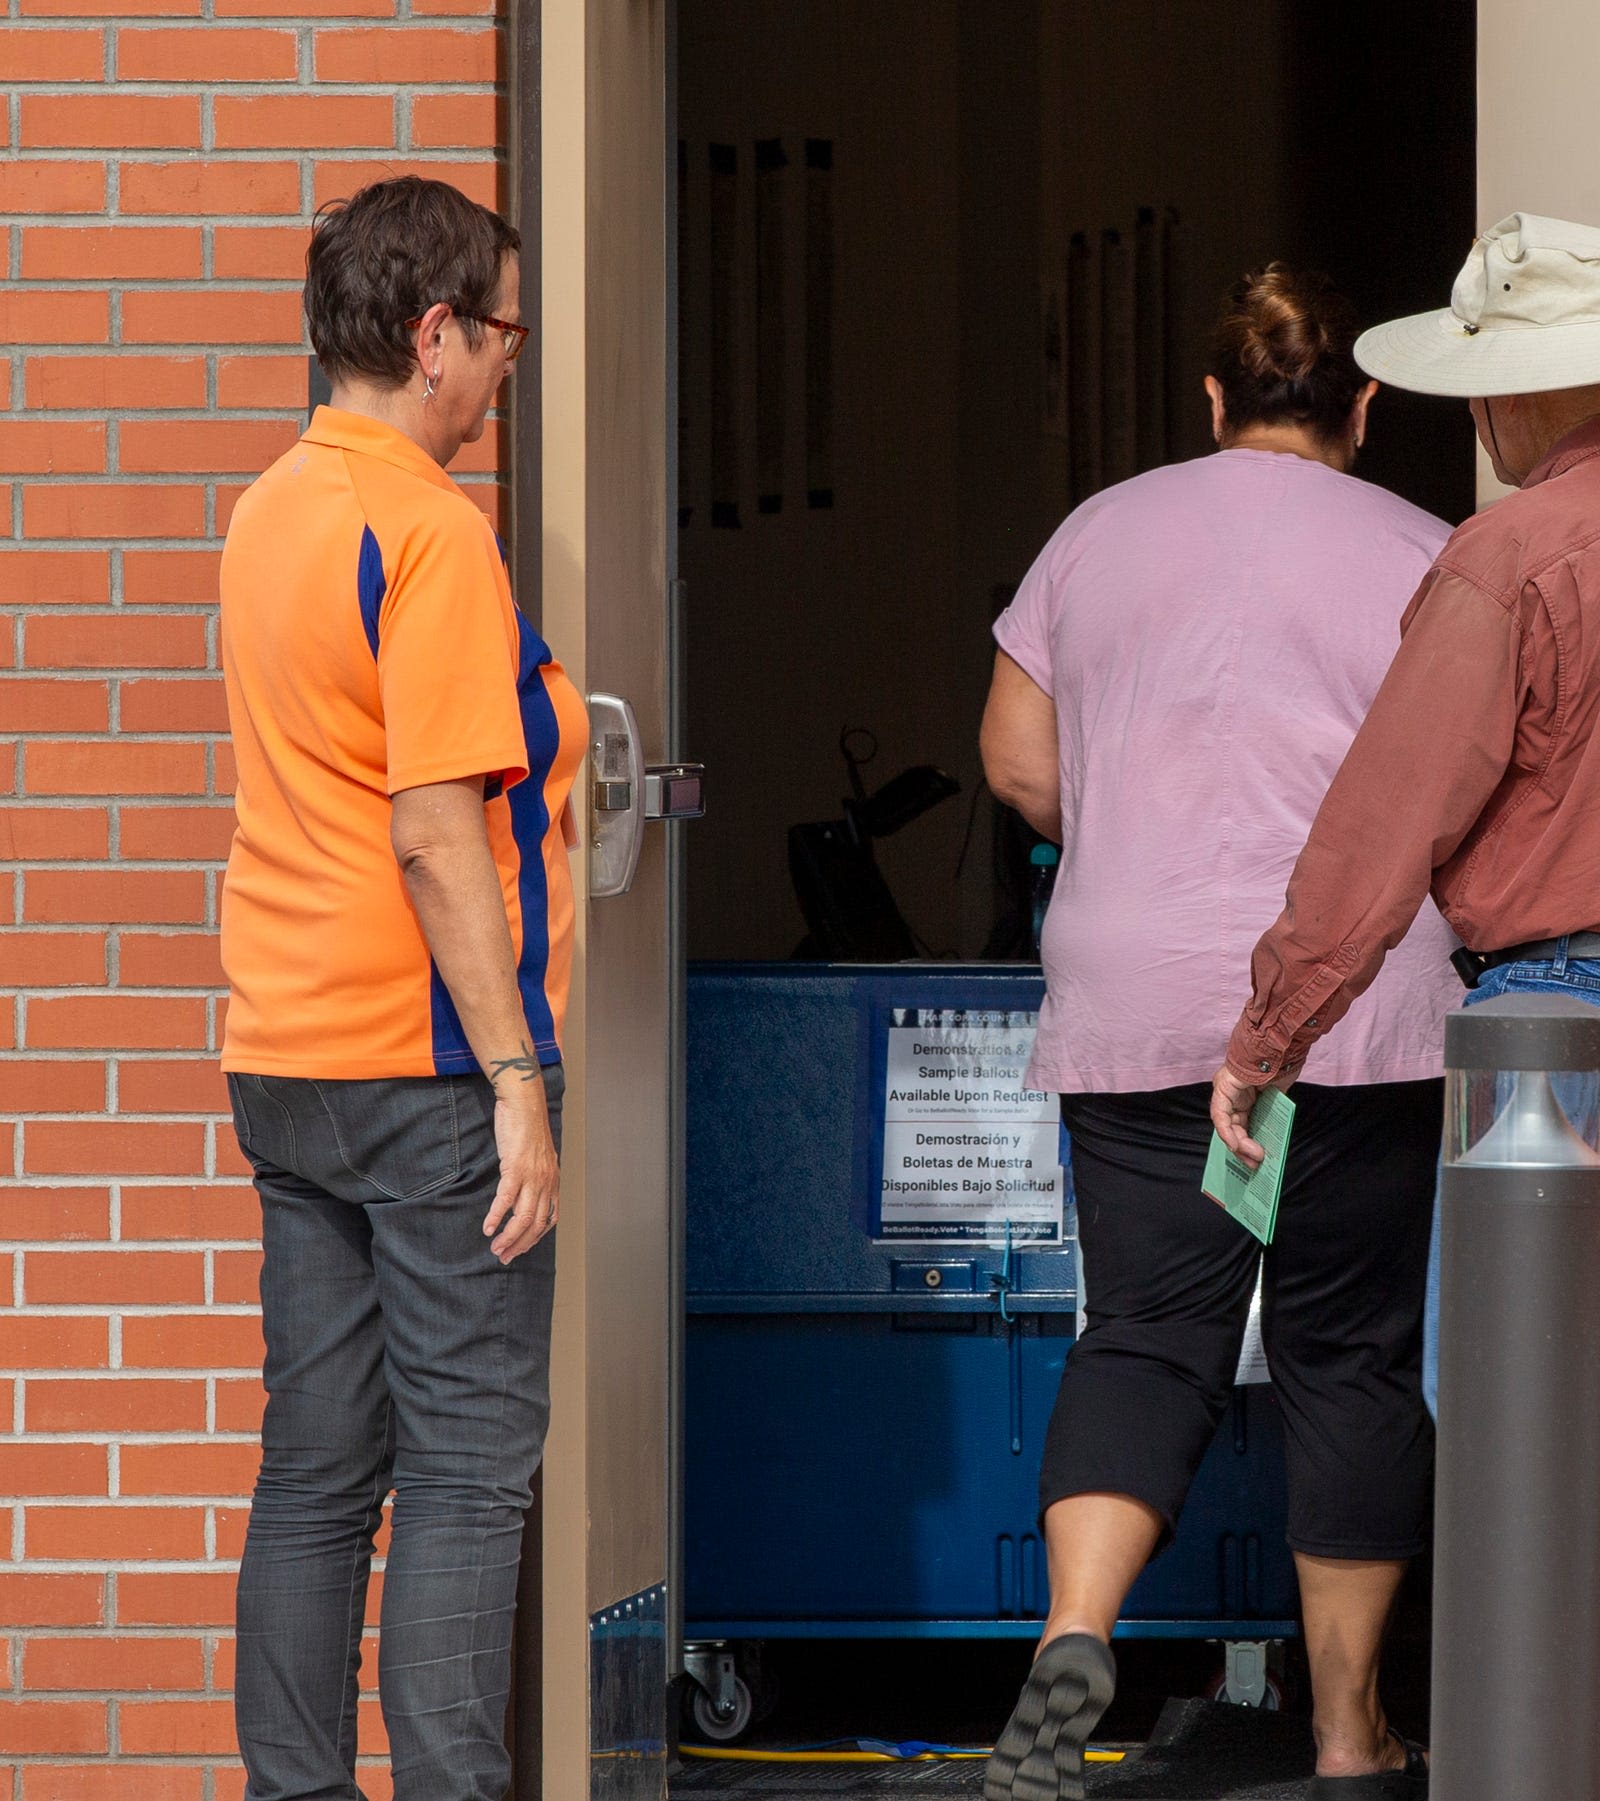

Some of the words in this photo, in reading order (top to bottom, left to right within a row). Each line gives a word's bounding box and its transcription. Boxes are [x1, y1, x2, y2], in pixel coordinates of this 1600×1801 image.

[913, 1043, 1012, 1056] Demonstration
[1016, 1043, 1026, 1056] &
[918, 1066, 969, 1081] Sample
[972, 1066, 1020, 1079] Ballots
[889, 1089, 950, 1102] Available
[954, 1090, 989, 1105] Upon
[993, 1090, 1049, 1105] Request
[916, 1133, 1009, 1146] Demostración
[1013, 1135, 1021, 1149] y
[903, 1156, 953, 1169] Boletas
[957, 1156, 973, 1169] de
[977, 1156, 1033, 1169] Muestra
[881, 1179, 958, 1194] Disponibles
[962, 1179, 992, 1194] Bajo
[996, 1179, 1055, 1192] Solicitud
